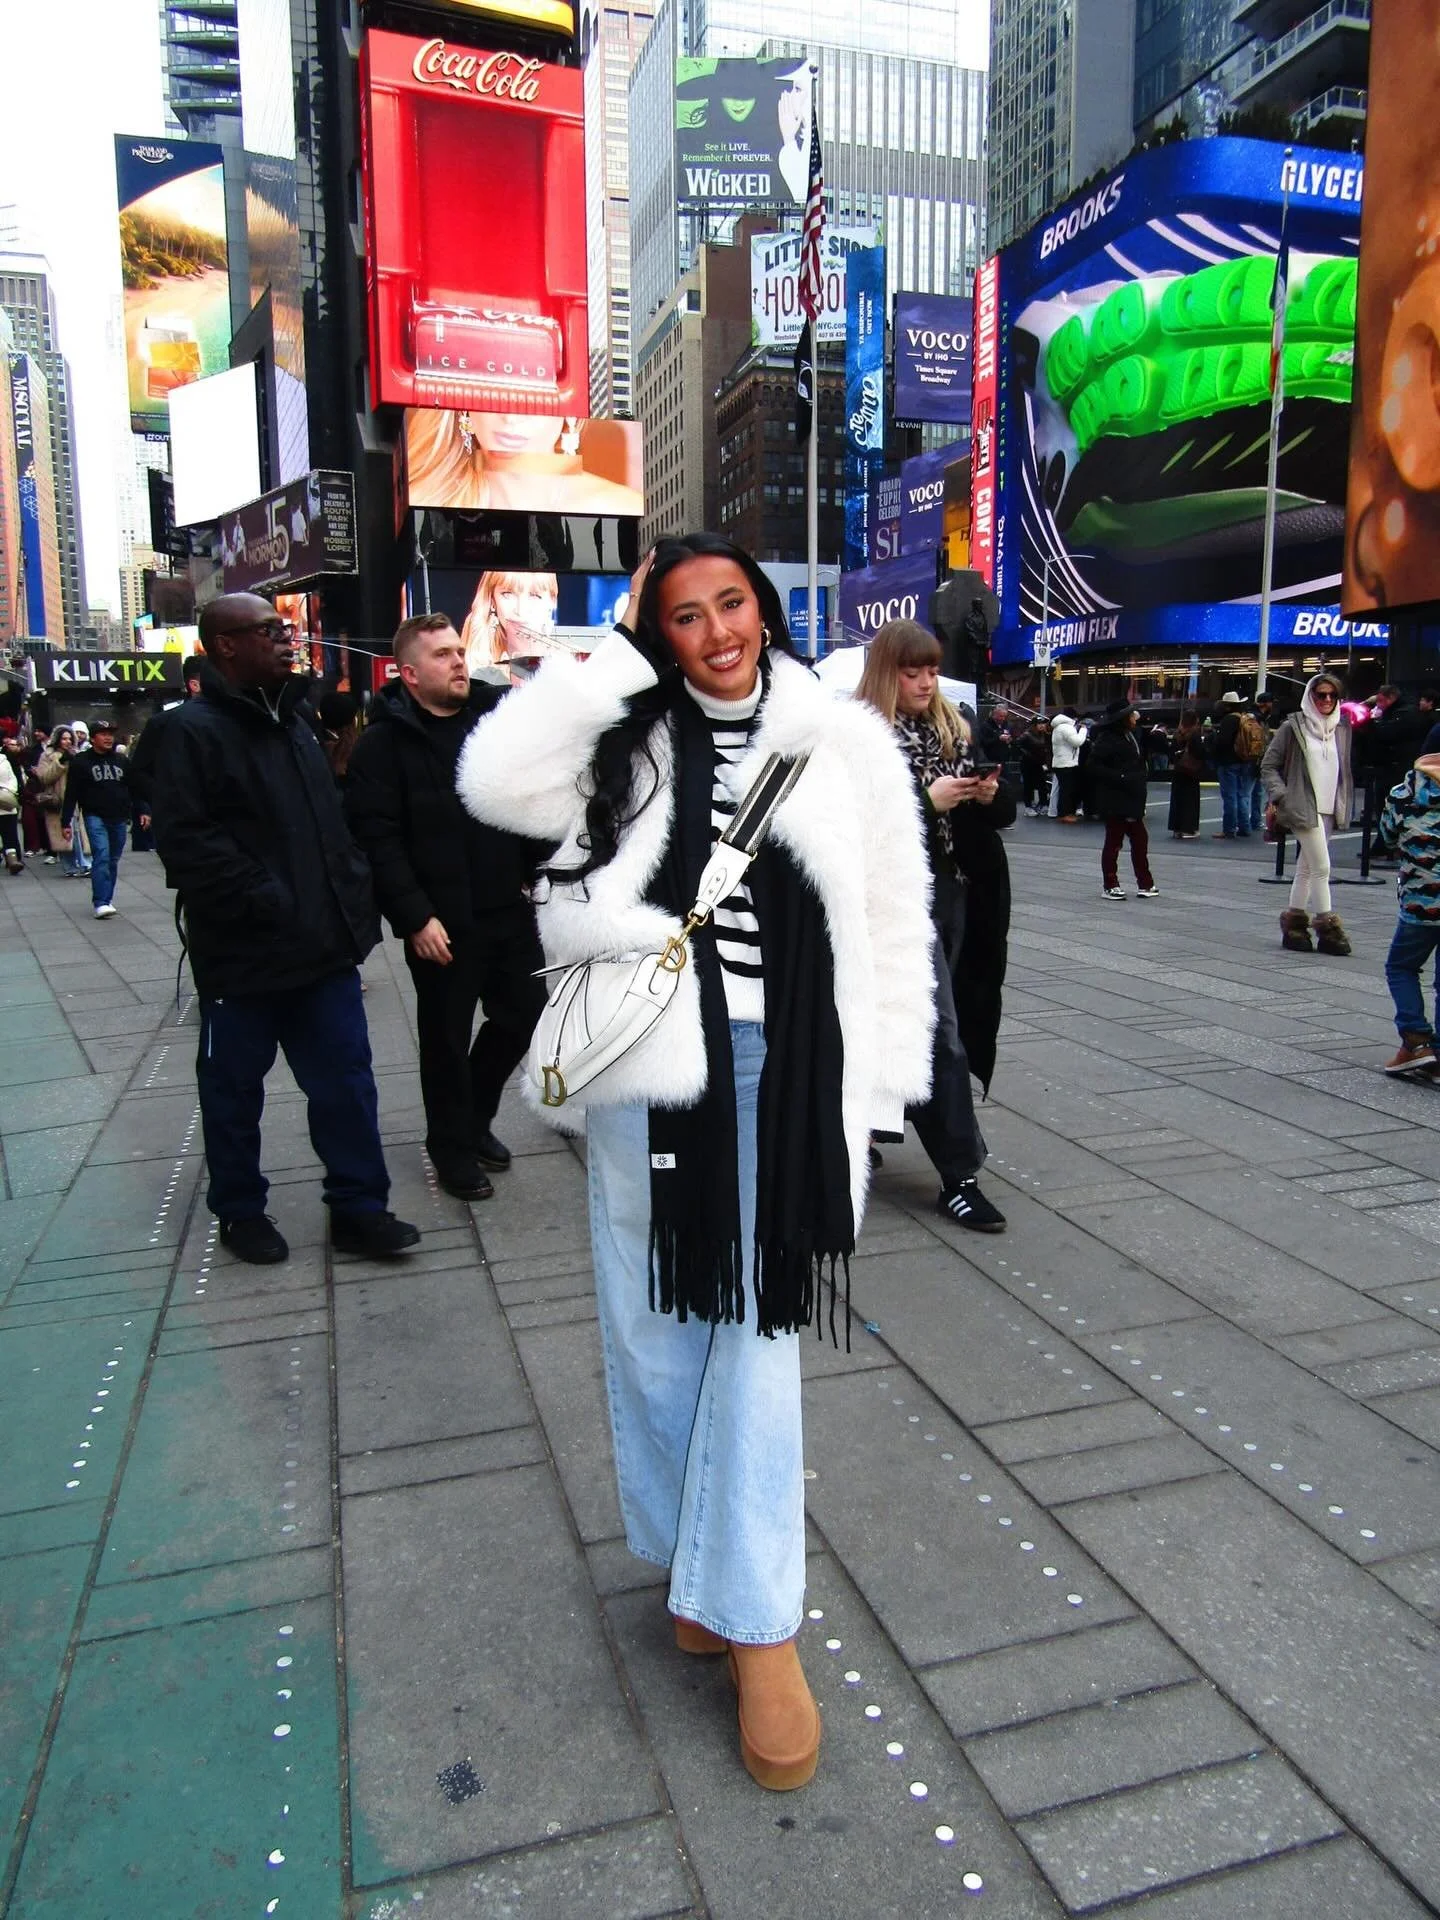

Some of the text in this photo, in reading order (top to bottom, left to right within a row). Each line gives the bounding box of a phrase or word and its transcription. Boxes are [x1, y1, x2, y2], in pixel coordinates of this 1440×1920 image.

[412, 38, 545, 102] Coca-Cola
[704, 143, 719, 151] See
[729, 143, 751, 151] LIVE.
[682, 154, 723, 162] Remember
[732, 154, 773, 162] FOREVER.
[1040, 174, 1125, 260] BROOKS
[924, 352, 933, 360] BY
[427, 354, 547, 377] ICE COLD
[915, 364, 958, 376] Times Square
[920, 374, 952, 386] Broadway
[327, 544, 352, 552] LOPEZ
[1089, 616, 1119, 642] FLEX
[52, 659, 166, 681] KLIKTIX
[91, 764, 124, 781] GAP
